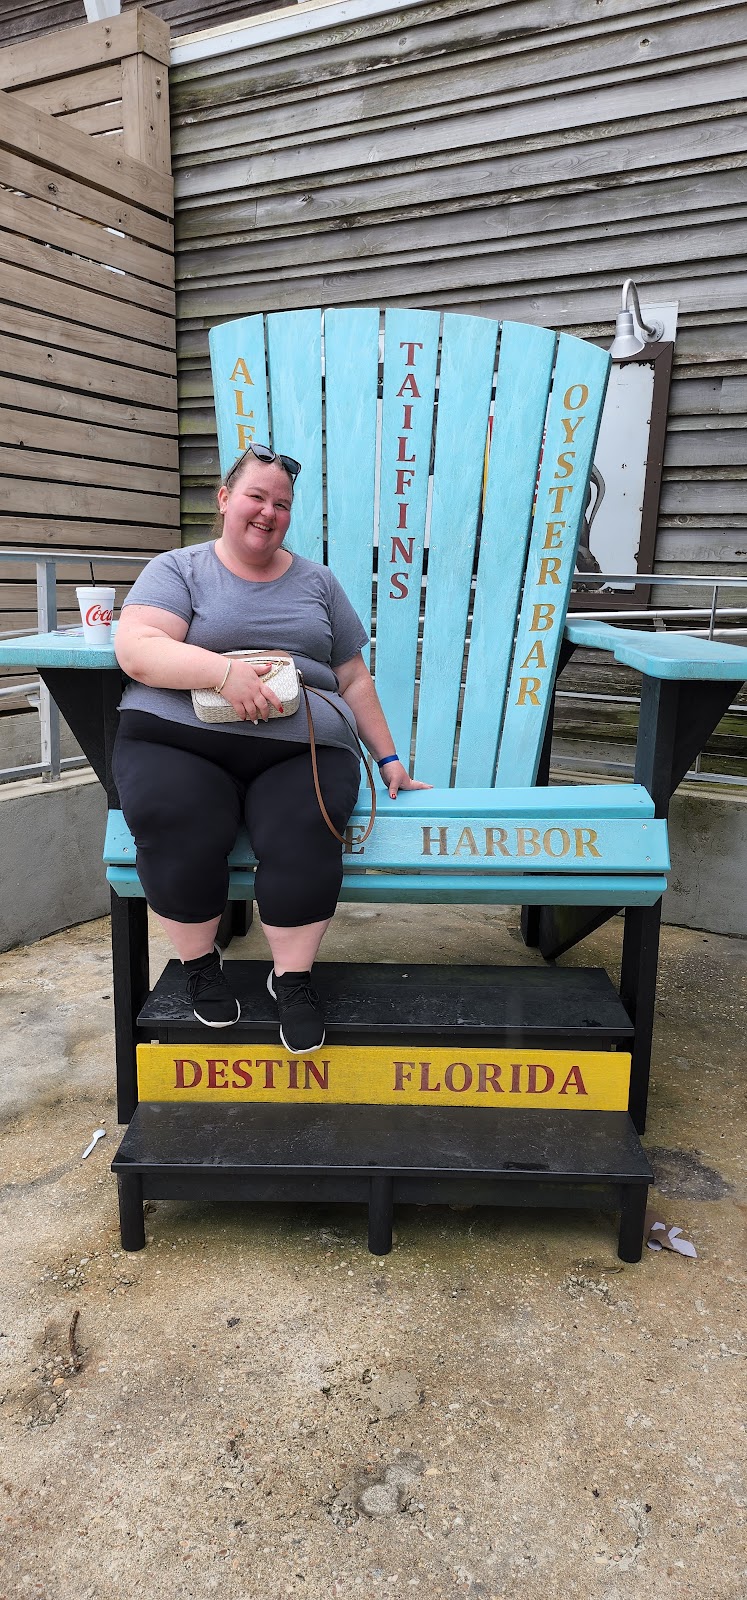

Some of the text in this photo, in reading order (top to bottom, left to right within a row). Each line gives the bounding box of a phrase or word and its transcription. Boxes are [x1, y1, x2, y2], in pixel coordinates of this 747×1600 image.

[389, 342, 424, 600] TAILFINS
[515, 383, 590, 707] OYSTER BAR
[420, 825, 603, 859] HARBOR
[172, 1058, 589, 1096] DESTIN FLORIDA
